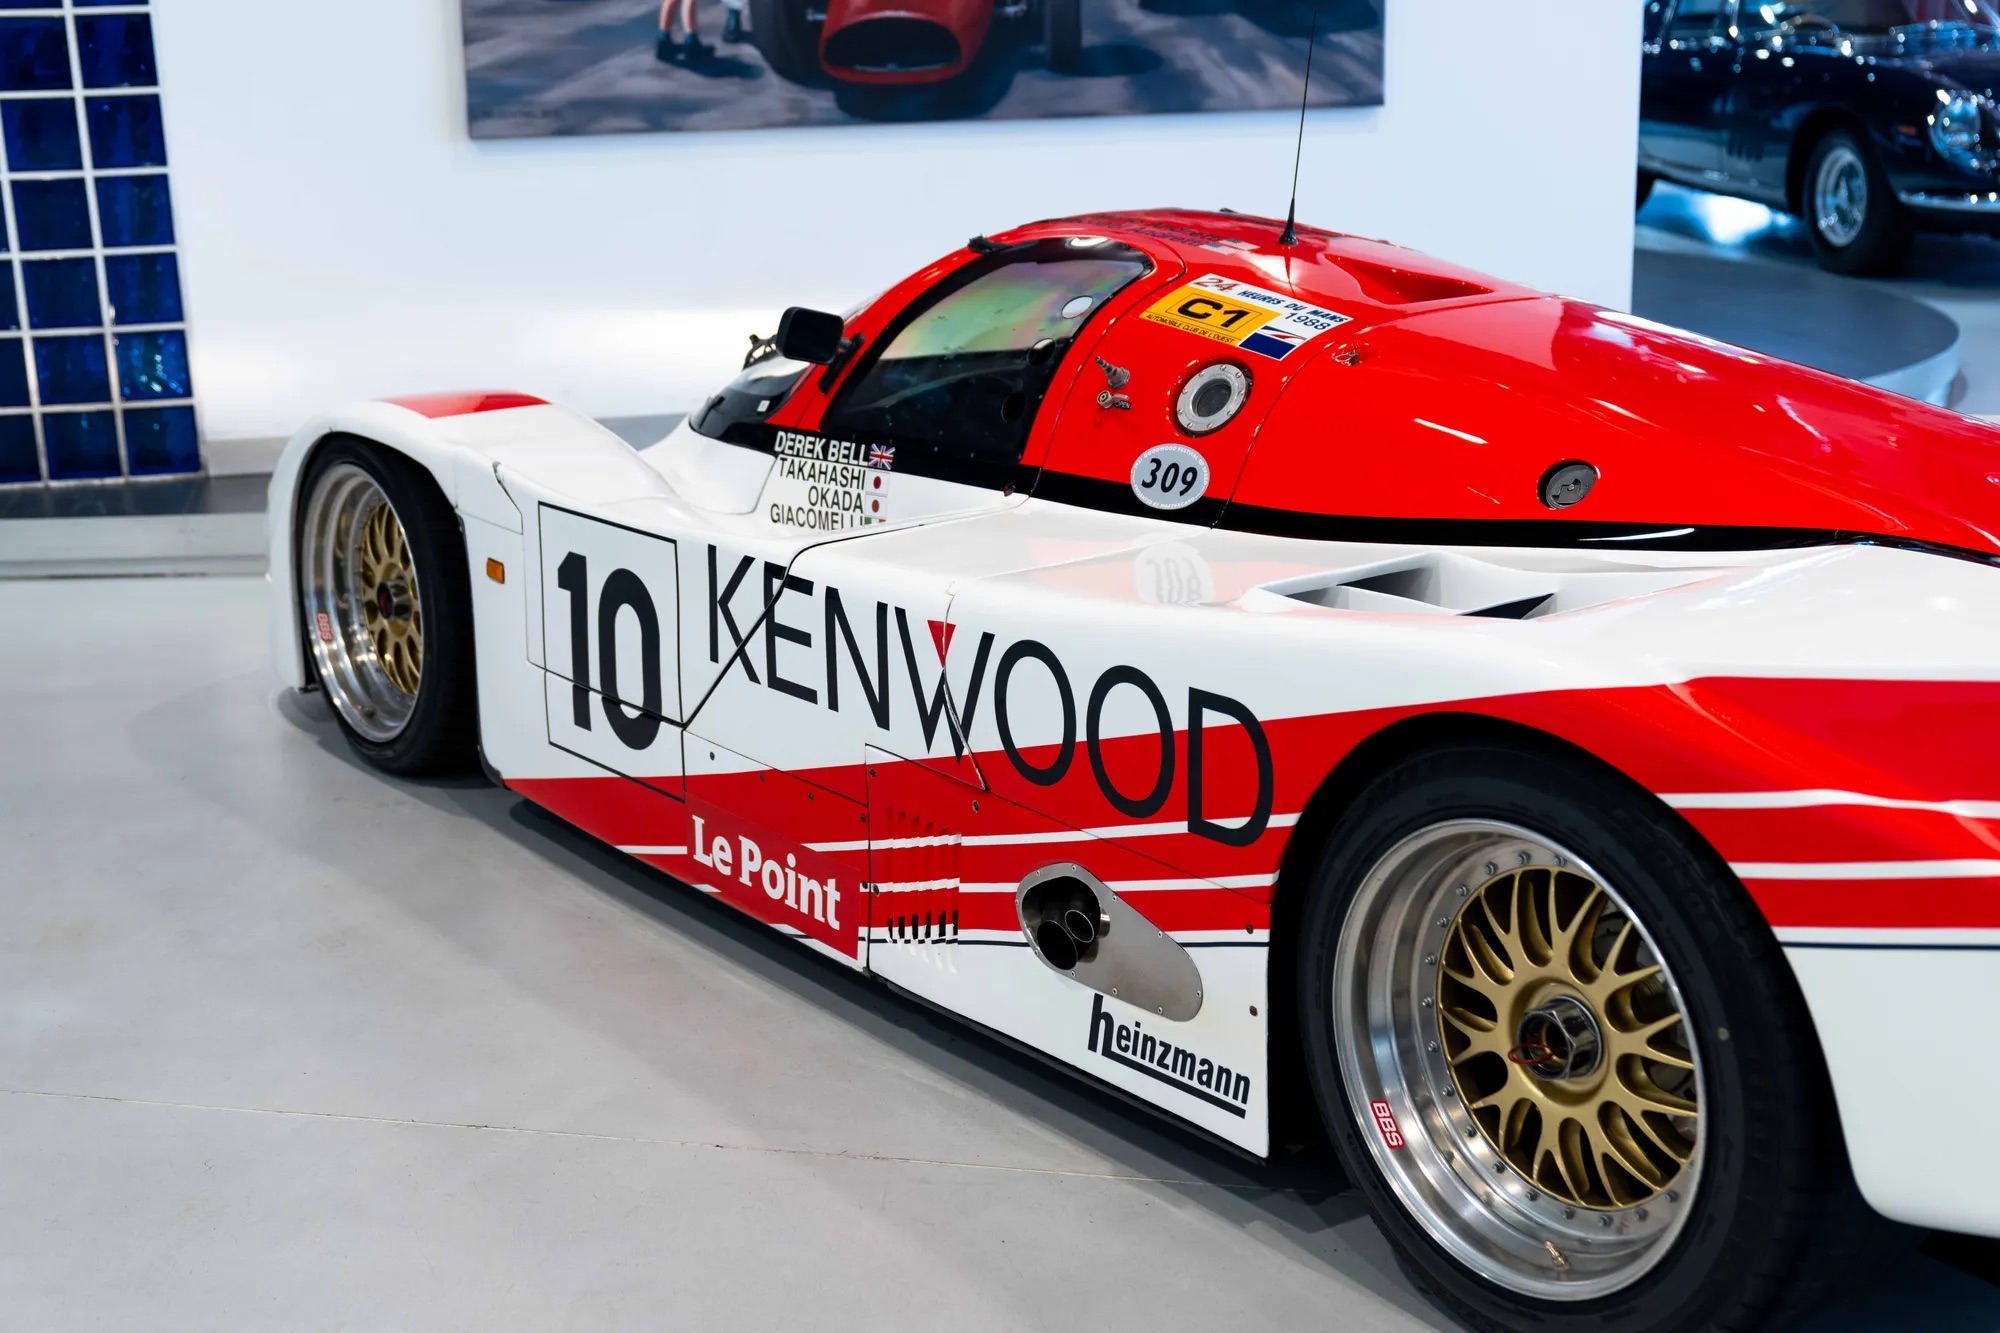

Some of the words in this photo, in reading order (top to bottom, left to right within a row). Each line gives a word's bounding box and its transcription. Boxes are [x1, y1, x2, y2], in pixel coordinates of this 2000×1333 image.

[1177, 298, 1251, 328] C1
[1194, 277, 1240, 293] 24
[1237, 290, 1286, 305] HEURES
[1284, 301, 1308, 311] DU
[1305, 306, 1348, 324] MANS
[1146, 314, 1182, 328] AUTOMOBILE
[1182, 324, 1200, 335] CLUB
[1284, 312, 1332, 331] 1988
[774, 430, 827, 460] DEREK
[827, 440, 869, 466] BELL
[1177, 446, 1198, 461] FESTIVAL
[779, 457, 867, 490] TAKAHASHI
[1141, 458, 1198, 496] 309
[808, 485, 864, 514] OKADA
[557, 551, 663, 750] 10
[707, 544, 1274, 847] KENWOOD
[692, 814, 733, 876] Le
[738, 834, 841, 930] Point
[1088, 993, 1250, 1107] heinzmann
[1373, 1102, 1403, 1146] BBS
